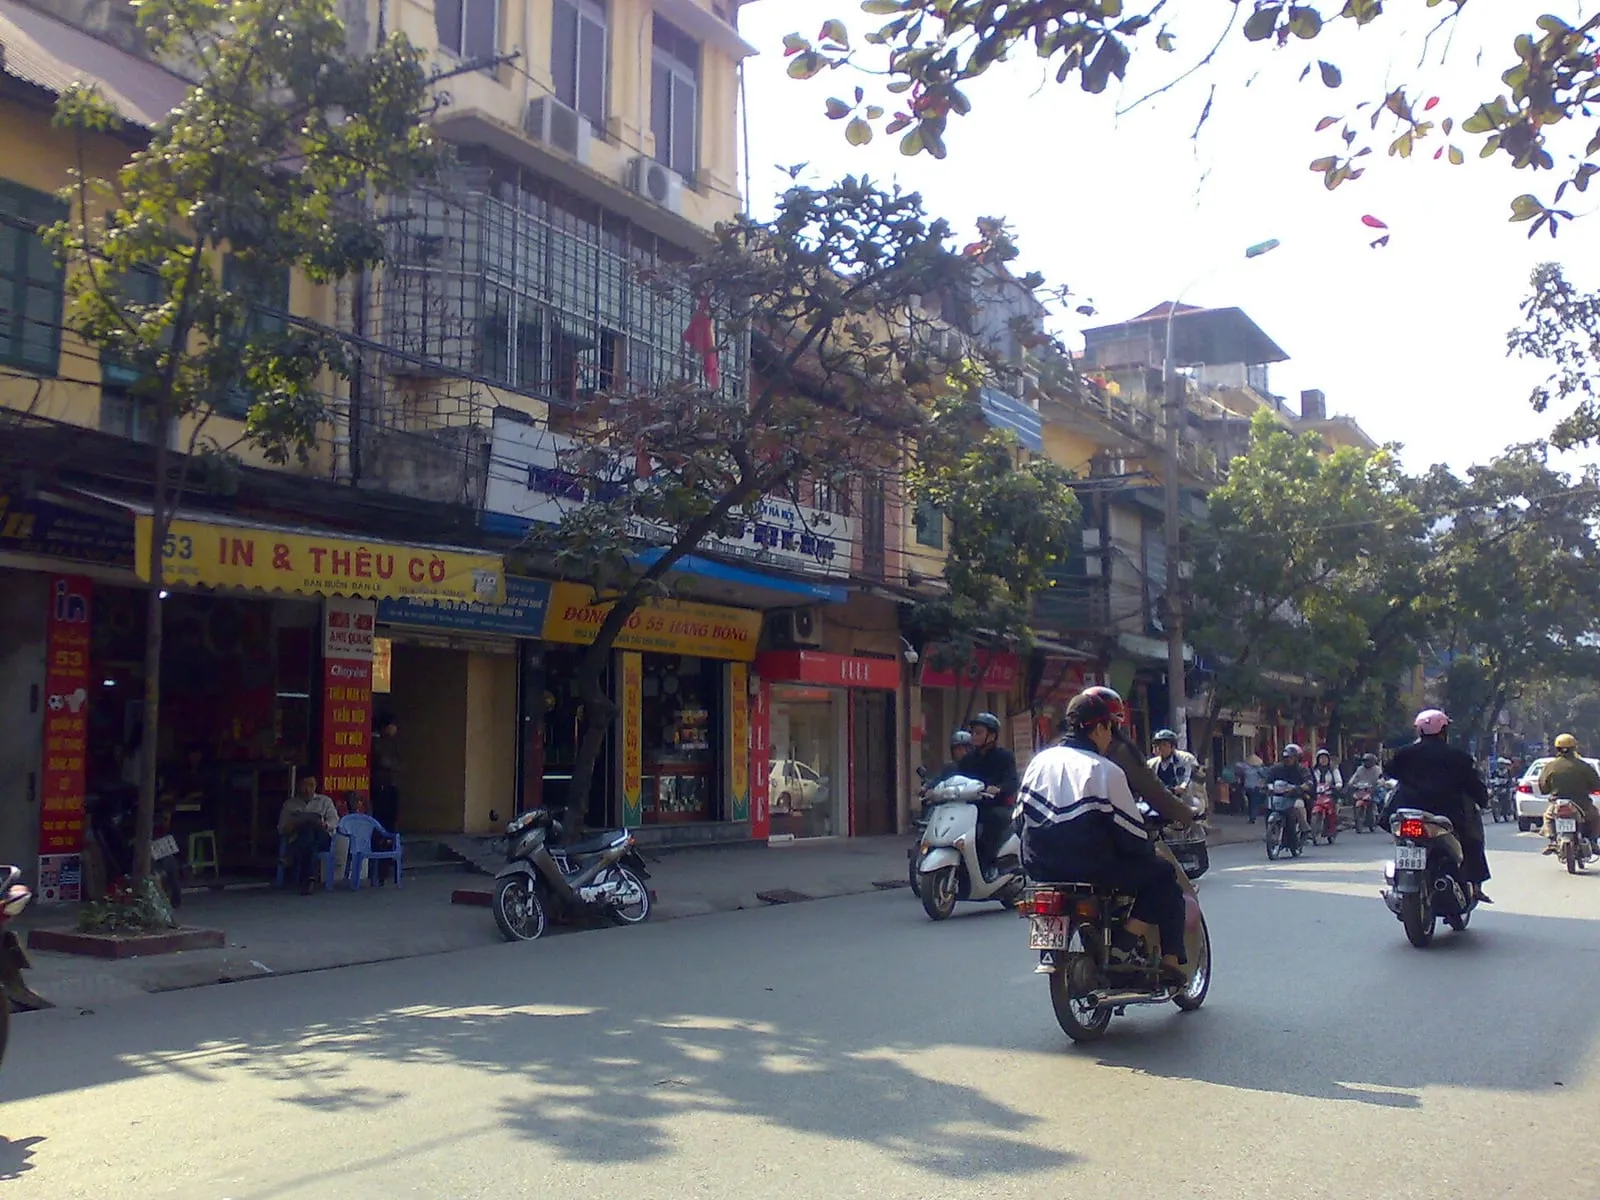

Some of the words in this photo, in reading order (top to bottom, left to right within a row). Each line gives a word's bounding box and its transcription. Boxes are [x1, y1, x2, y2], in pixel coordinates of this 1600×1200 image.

[162, 533, 193, 560] 53
[219, 537, 255, 567] IN
[272, 543, 294, 572] &
[308, 546, 395, 580] THÊU
[408, 553, 446, 583] CỜ
[56, 649, 82, 667] 53
